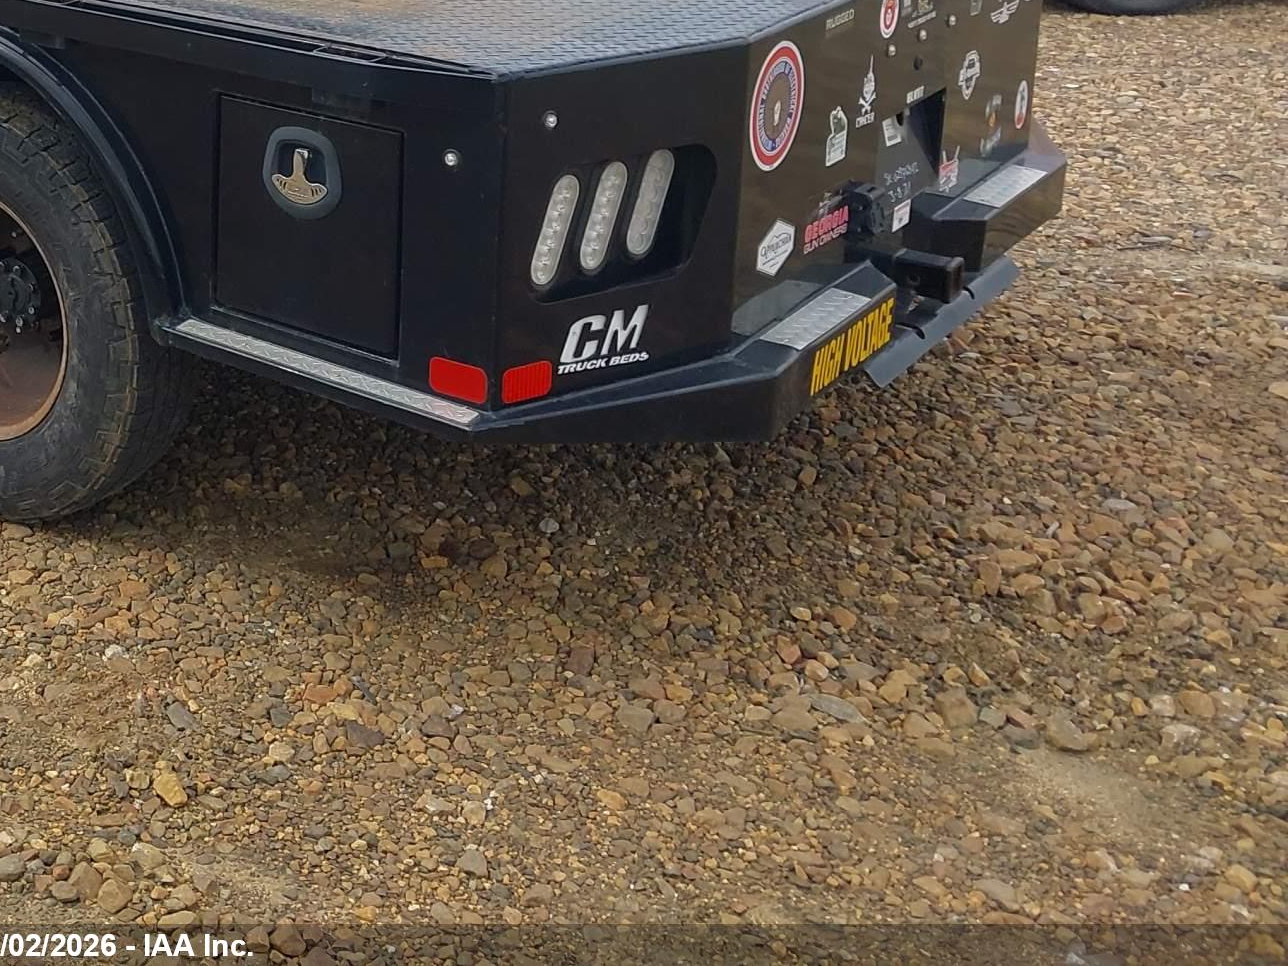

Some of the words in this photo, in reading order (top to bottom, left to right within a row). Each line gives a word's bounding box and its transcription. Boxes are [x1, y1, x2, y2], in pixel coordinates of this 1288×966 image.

[804, 205, 849, 244] GEORGIA
[559, 304, 649, 363] CM
[810, 333, 845, 396] HIGH
[844, 298, 895, 369] VOLTAGE
[557, 357, 608, 375] TRUCK
[609, 351, 650, 366] BEDS
